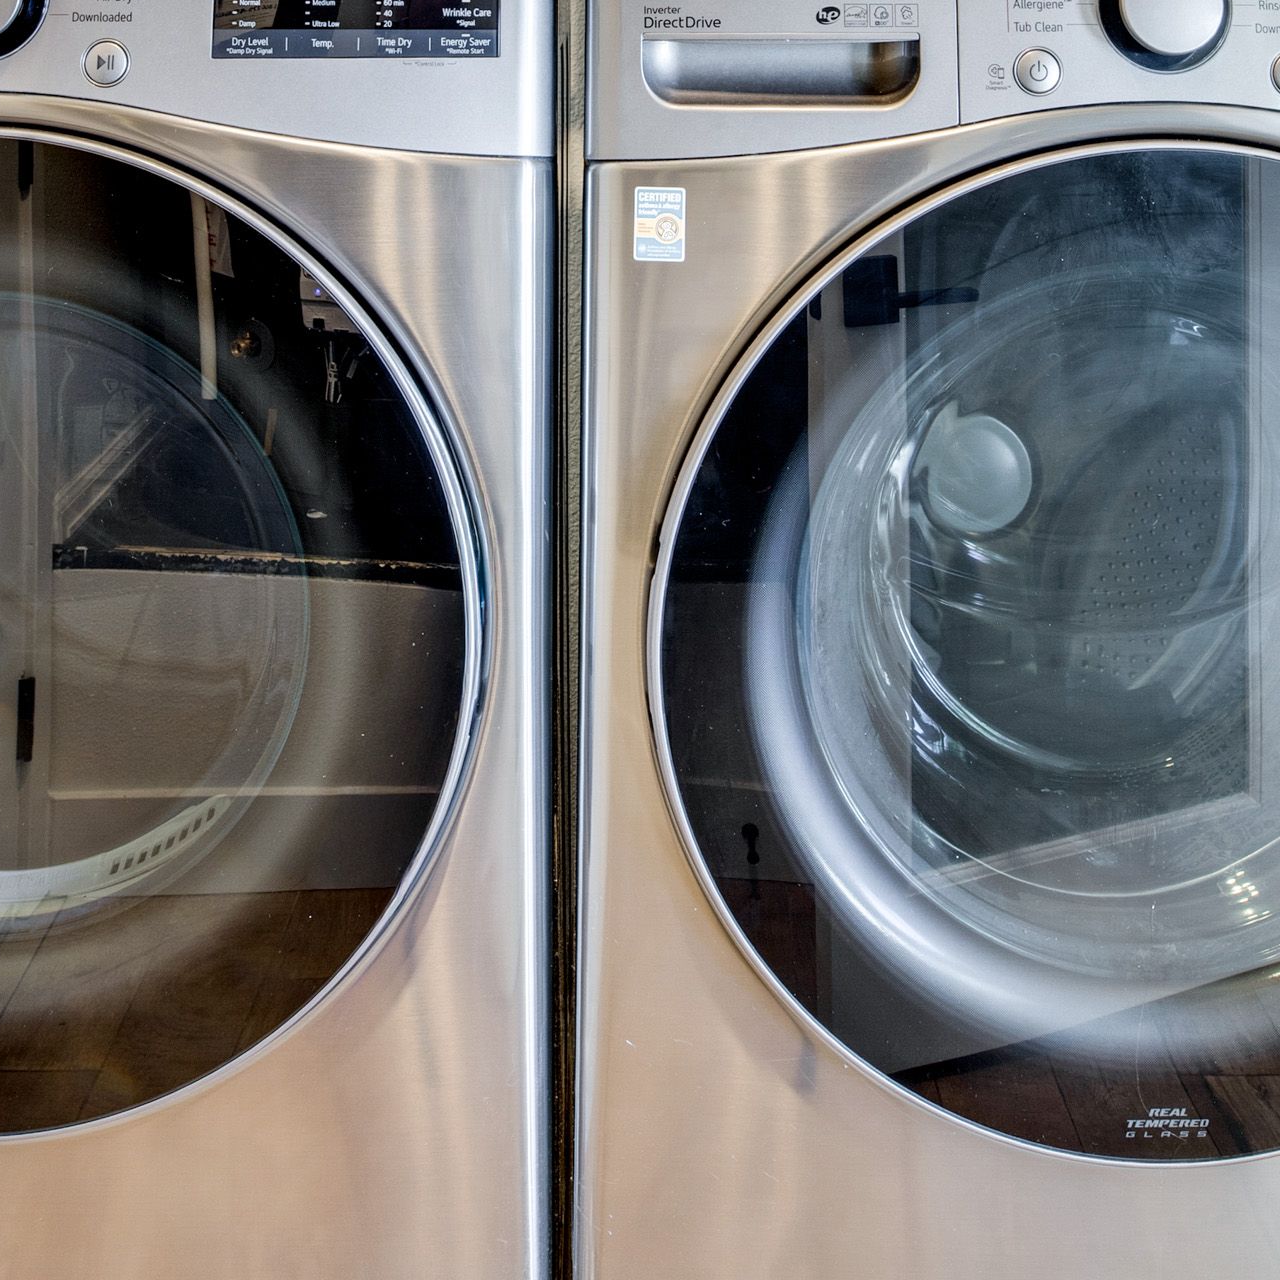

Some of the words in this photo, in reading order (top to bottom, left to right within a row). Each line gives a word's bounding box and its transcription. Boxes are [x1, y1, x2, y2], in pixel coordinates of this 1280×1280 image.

[442, 8, 472, 17] Wrinkle
[473, 8, 491, 17] Care
[643, 6, 681, 14] Inverter
[72, 12, 133, 23] Downloaded
[1013, 22, 1032, 33] Tub
[1035, 22, 1063, 32] Clean
[232, 38, 245, 47] Dry
[248, 37, 268, 46] Level
[311, 39, 334, 48] Temp.
[376, 37, 395, 46] Time
[398, 38, 412, 48] Dry
[441, 38, 467, 48] Energy
[469, 38, 491, 46] Saver
[256, 48, 273, 56] Signal
[639, 192, 681, 202] CERTIFIED
[1149, 1108, 1188, 1117] REAL
[1126, 1119, 1209, 1128] TEMPERED
